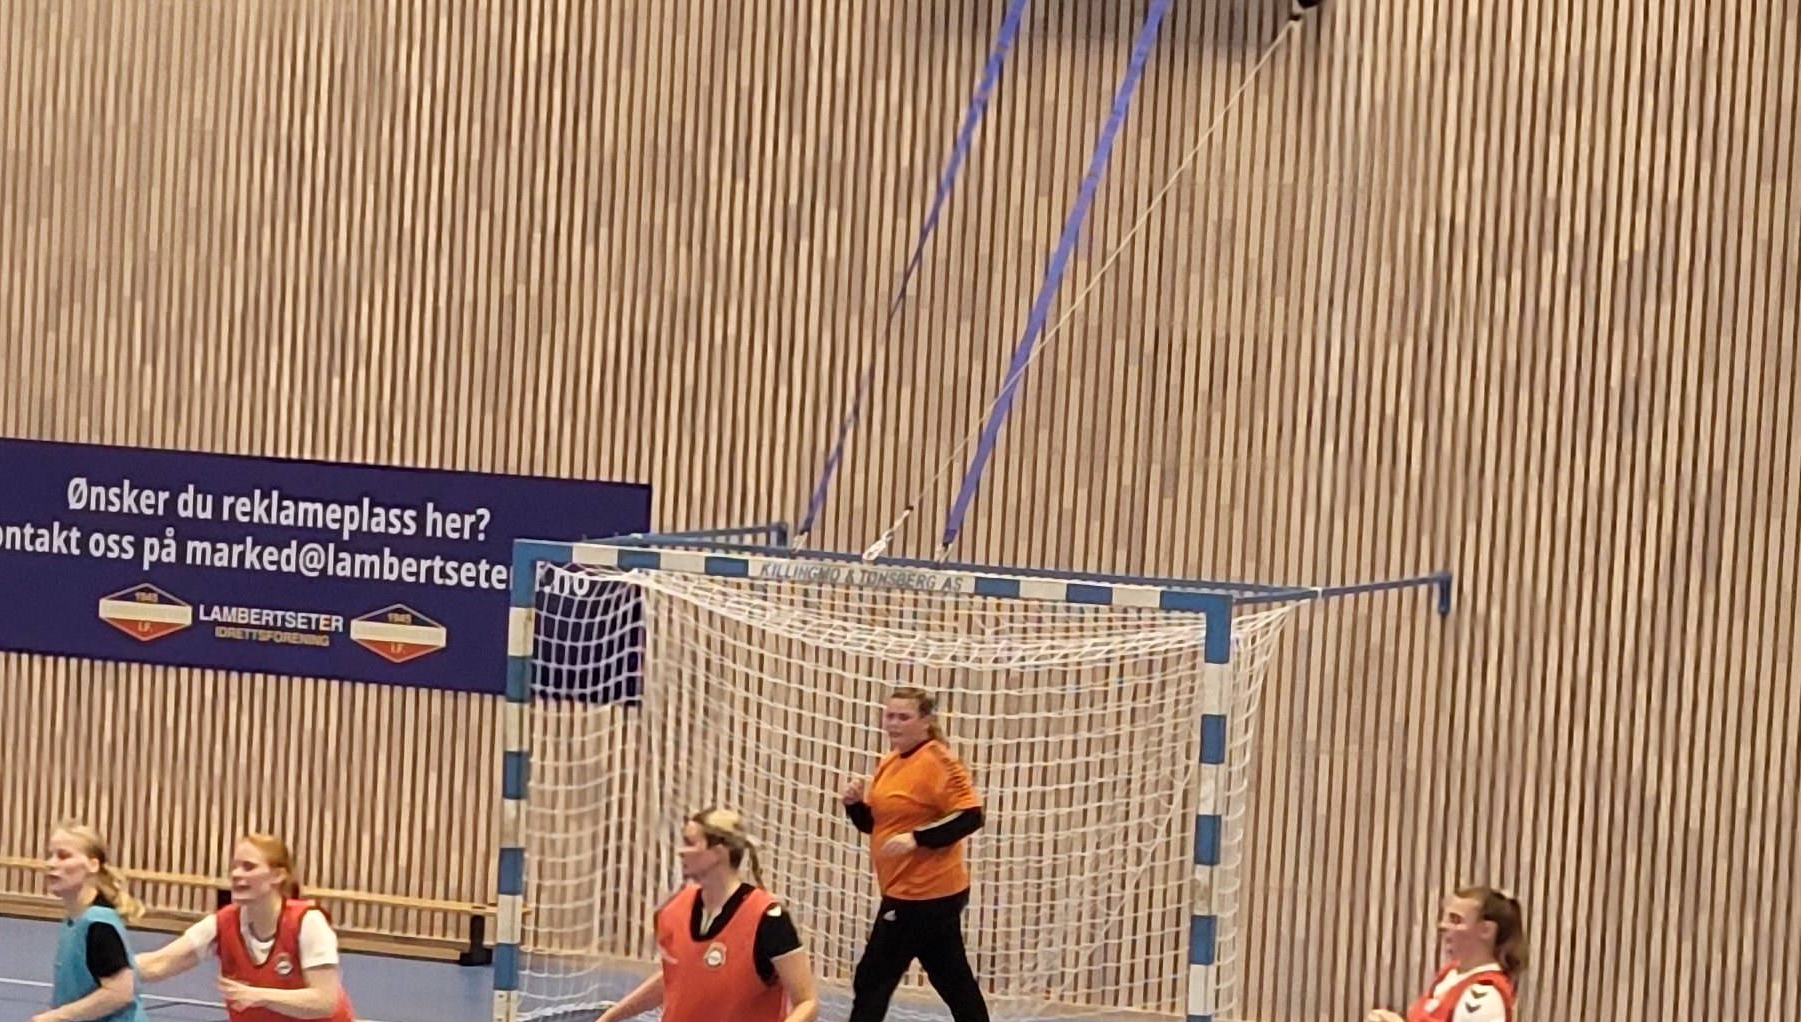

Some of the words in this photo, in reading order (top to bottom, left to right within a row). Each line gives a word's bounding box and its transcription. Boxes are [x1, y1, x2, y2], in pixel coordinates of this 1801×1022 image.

[67, 477, 169, 516] Ønsker
[177, 484, 212, 519] du
[222, 489, 417, 541] reklameplass
[426, 502, 491, 541] her?
[89, 531, 135, 559] oss
[143, 526, 176, 570] på
[941, 577, 964, 592] AS
[199, 604, 344, 633] LAMBERTSETER
[215, 625, 330, 647] IDRETTSFORENING
